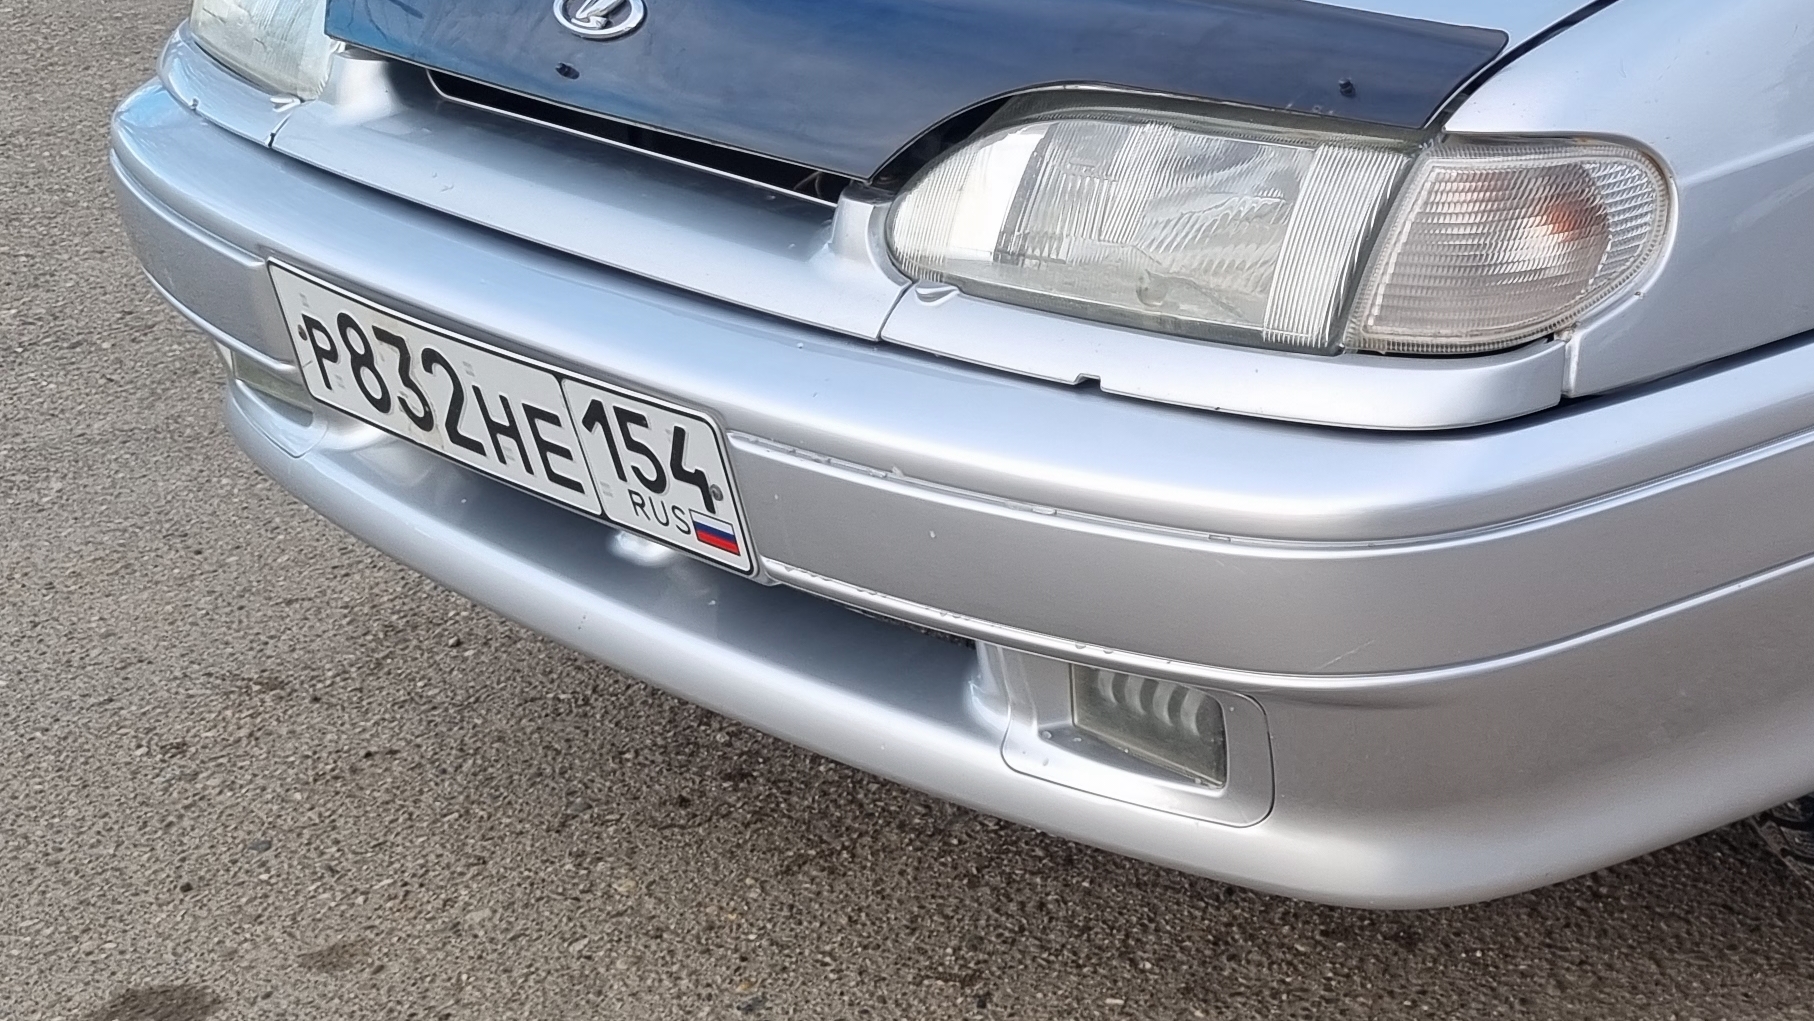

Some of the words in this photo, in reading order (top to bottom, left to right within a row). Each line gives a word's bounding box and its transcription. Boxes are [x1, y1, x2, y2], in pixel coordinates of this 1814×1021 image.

[301, 311, 586, 495] Р832НЕ
[581, 397, 716, 515] 154
[627, 488, 692, 535] RUS
